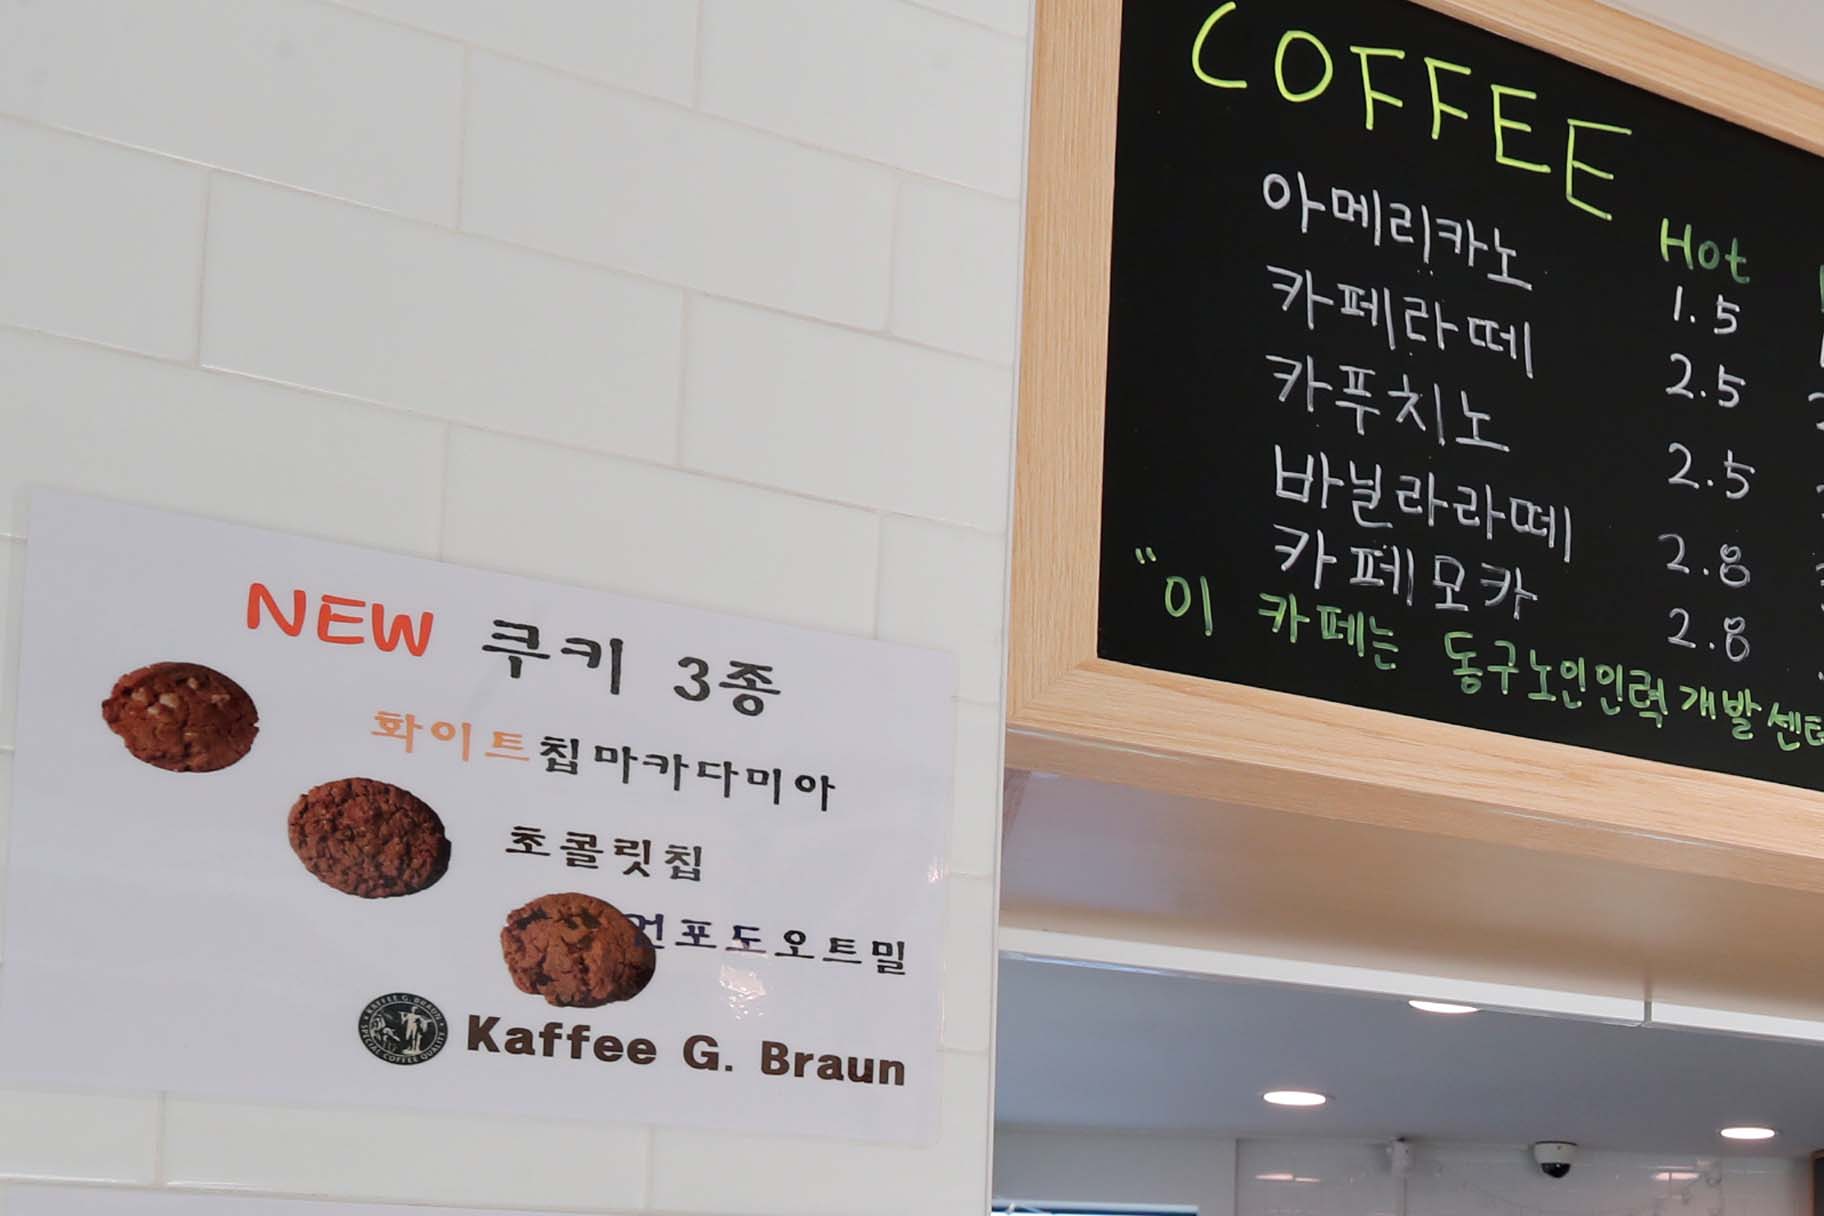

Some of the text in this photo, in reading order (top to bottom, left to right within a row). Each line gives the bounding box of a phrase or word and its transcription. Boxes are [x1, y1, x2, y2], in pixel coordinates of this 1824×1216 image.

[1192, 1, 1632, 220] COFFEE
[1263, 171, 1532, 291] 아메리카노
[1659, 217, 1750, 284] Hot
[1267, 265, 1534, 379] 카페라떼
[1672, 286, 1741, 335] 1.5
[1266, 355, 1510, 452] 카푸치노
[1665, 353, 1747, 408] 2.5
[1275, 444, 1571, 563] 바닐라라떼
[1668, 442, 1755, 499] 2.5
[1658, 534, 1750, 588] 2.8
[246, 582, 782, 718] NEW 쿠키 3종
[1258, 591, 1399, 670] 카페는
[1668, 608, 1750, 662] 2.8
[505, 825, 703, 882] 초콜릿칩
[466, 1014, 906, 1087] Kaffee G. Braun
